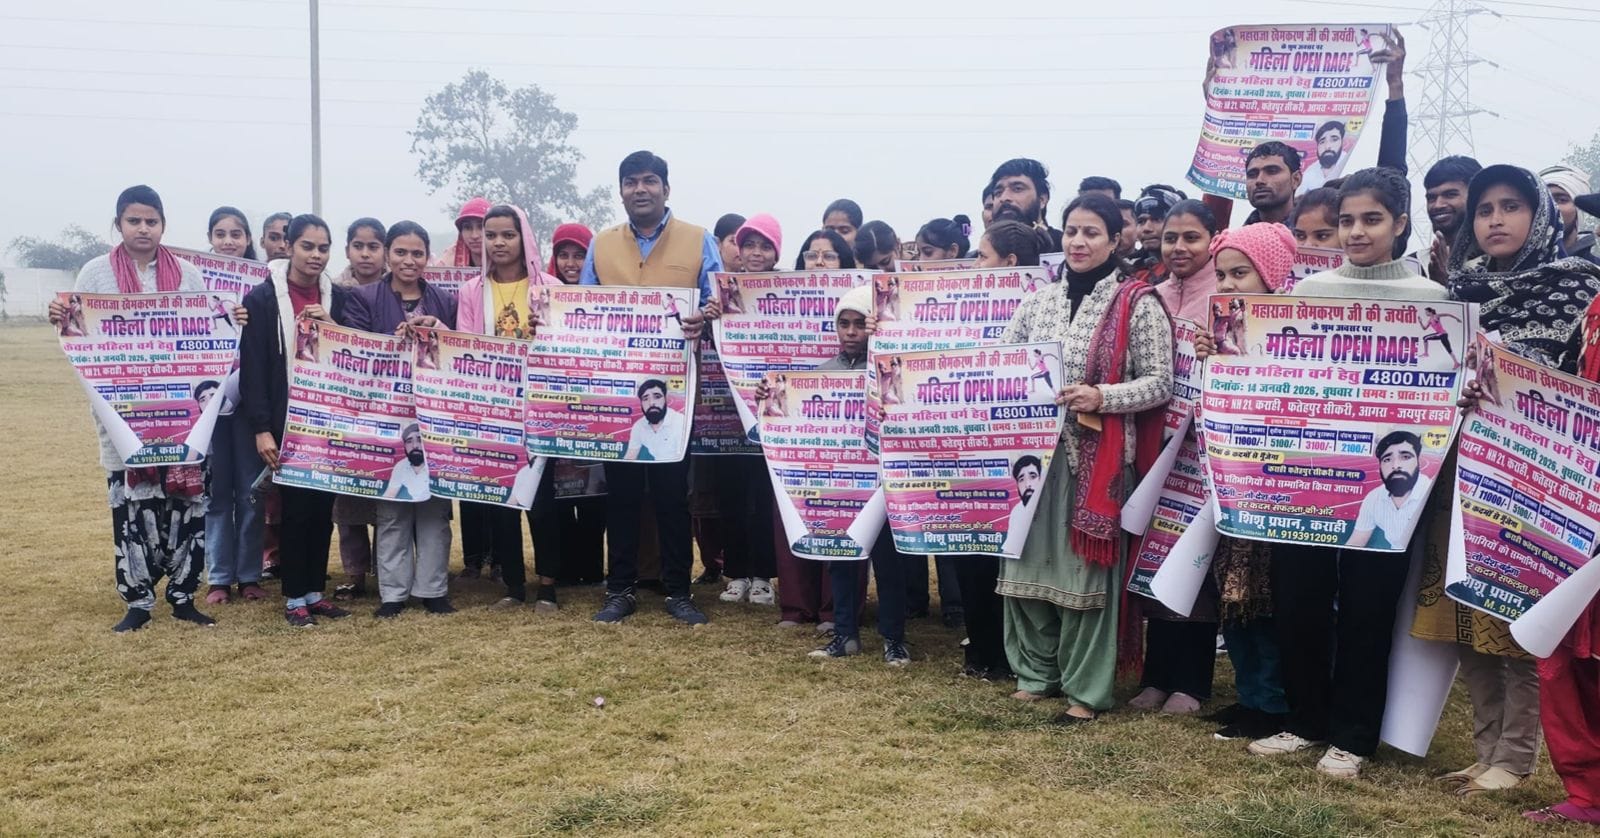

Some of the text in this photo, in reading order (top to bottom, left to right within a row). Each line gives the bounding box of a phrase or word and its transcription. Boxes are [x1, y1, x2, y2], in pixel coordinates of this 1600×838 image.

[1306, 28, 1316, 42] जी
[1319, 28, 1329, 41] की
[1250, 46, 1353, 72] महिला OPEN RACE
[1317, 78, 1345, 87] 4800
[1347, 78, 1368, 87] Mtr
[159, 296, 169, 310] जी
[172, 295, 182, 310] की
[758, 293, 833, 316] महिला OPEN
[915, 298, 988, 322] महिला OPEN
[1252, 303, 1293, 318] महाराजा
[1348, 302, 1362, 321] जी
[1366, 303, 1380, 322] की
[1385, 304, 1418, 323] जयंती
[101, 315, 211, 337] महिला OPEN RACE
[565, 308, 662, 333] महिला OPEN RACE
[180, 340, 210, 350] 4800
[213, 340, 233, 350] Mtr
[631, 339, 681, 349] 4800 Mtr
[1266, 326, 1418, 366] महिला OPEN RACE
[331, 348, 400, 378] महिला OPEN
[453, 354, 521, 383] महिला OPEN
[975, 351, 986, 367] जी
[989, 350, 1000, 367] की
[1499, 358, 1537, 383] महाराजा
[1211, 362, 1449, 387] केवल महिला वर्ग हेतु 4800 Mtr
[917, 376, 1028, 404] महिला OPEN RACE
[1248, 383, 1256, 392] 14
[1260, 382, 1290, 394] जनवरी
[1322, 386, 1353, 398] बुधवार
[1363, 389, 1387, 399] समय
[801, 394, 841, 420] महिला
[995, 406, 1027, 418] 4800
[1031, 405, 1053, 417] Mtr
[1255, 399, 1284, 412] कराही,
[1288, 400, 1320, 417] फतेहपुर
[1323, 402, 1355, 417] सीकरी,
[1359, 406, 1387, 418] आगरा
[1397, 408, 1426, 423] जयपुर
[1516, 389, 1569, 436] महिला
[1510, 421, 1596, 475] महिला वर्ग हेतु
[1503, 436, 1511, 448] 14
[1512, 441, 1538, 460] जनवरी
[1561, 464, 1586, 486] बुधवार
[1532, 469, 1558, 494] फतेहपुर
[1267, 529, 1278, 538] M.
[1280, 530, 1338, 543] 9193912099
[1310, 518, 1348, 533] कराही
[1484, 599, 1496, 610] M.
